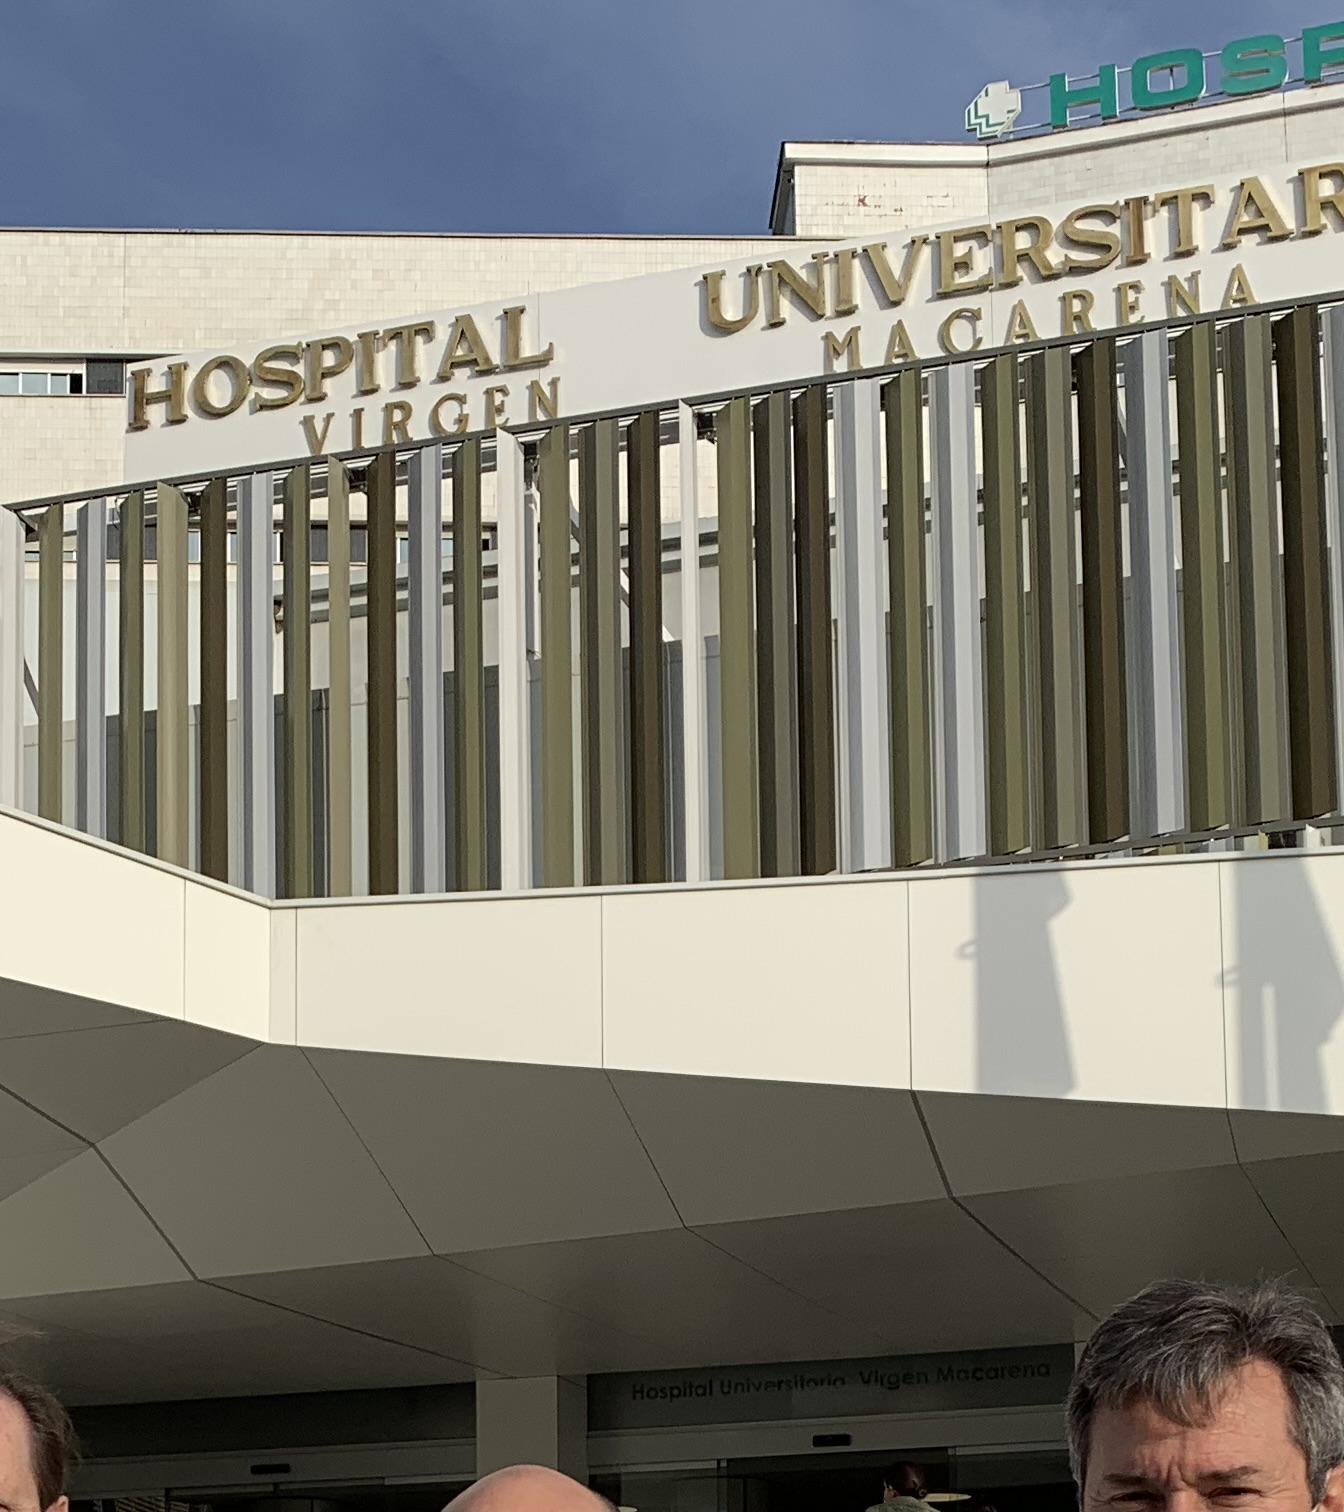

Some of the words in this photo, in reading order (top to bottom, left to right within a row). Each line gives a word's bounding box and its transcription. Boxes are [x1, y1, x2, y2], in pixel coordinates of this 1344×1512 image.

[126, 304, 555, 433] HOSPITAL
[301, 375, 561, 456] VIRGEN
[824, 262, 1260, 374] MACARENA
[632, 1379, 713, 1404] Hospital
[859, 1367, 929, 1391] Virgen
[936, 1360, 1052, 1385] Macarena
